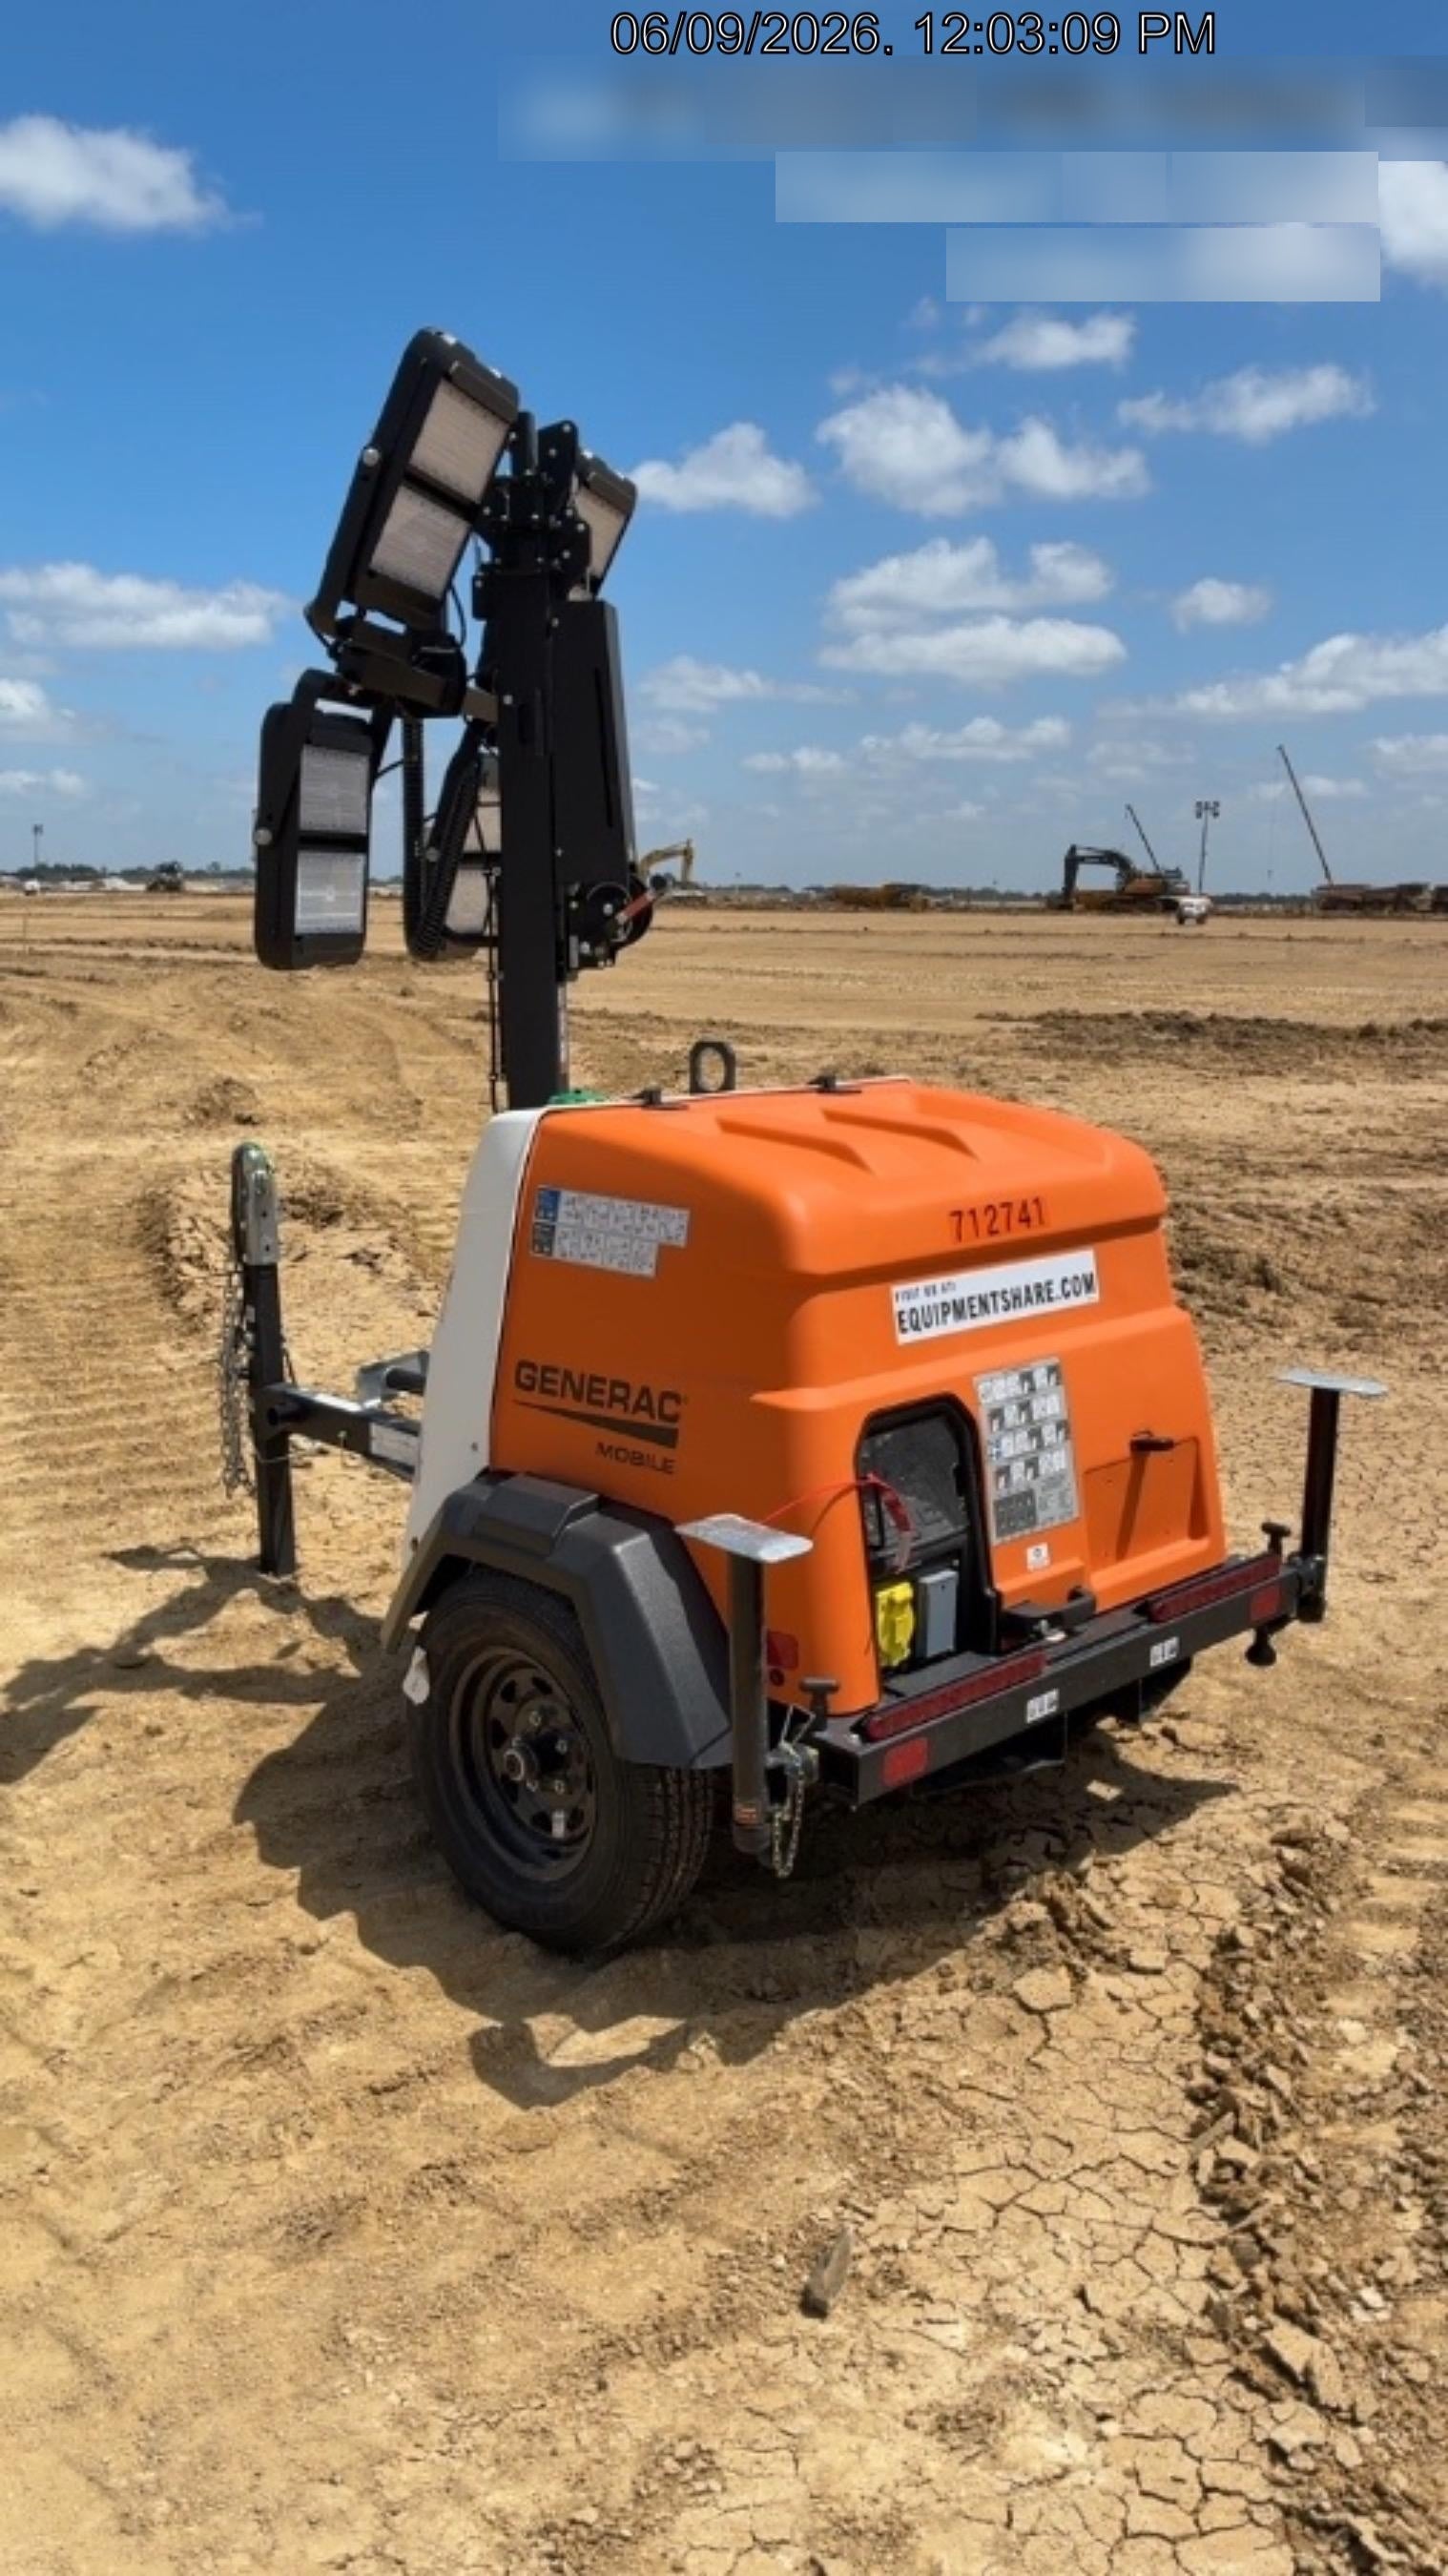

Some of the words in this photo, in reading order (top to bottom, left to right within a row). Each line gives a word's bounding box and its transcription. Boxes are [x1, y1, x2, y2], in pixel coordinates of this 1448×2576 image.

[948, 1196, 1045, 1242] 712741
[897, 1272, 1096, 1334] EQUIPMENTSHARE.COM
[514, 1360, 682, 1423] GENERAC
[595, 1441, 675, 1475] MOBILE
